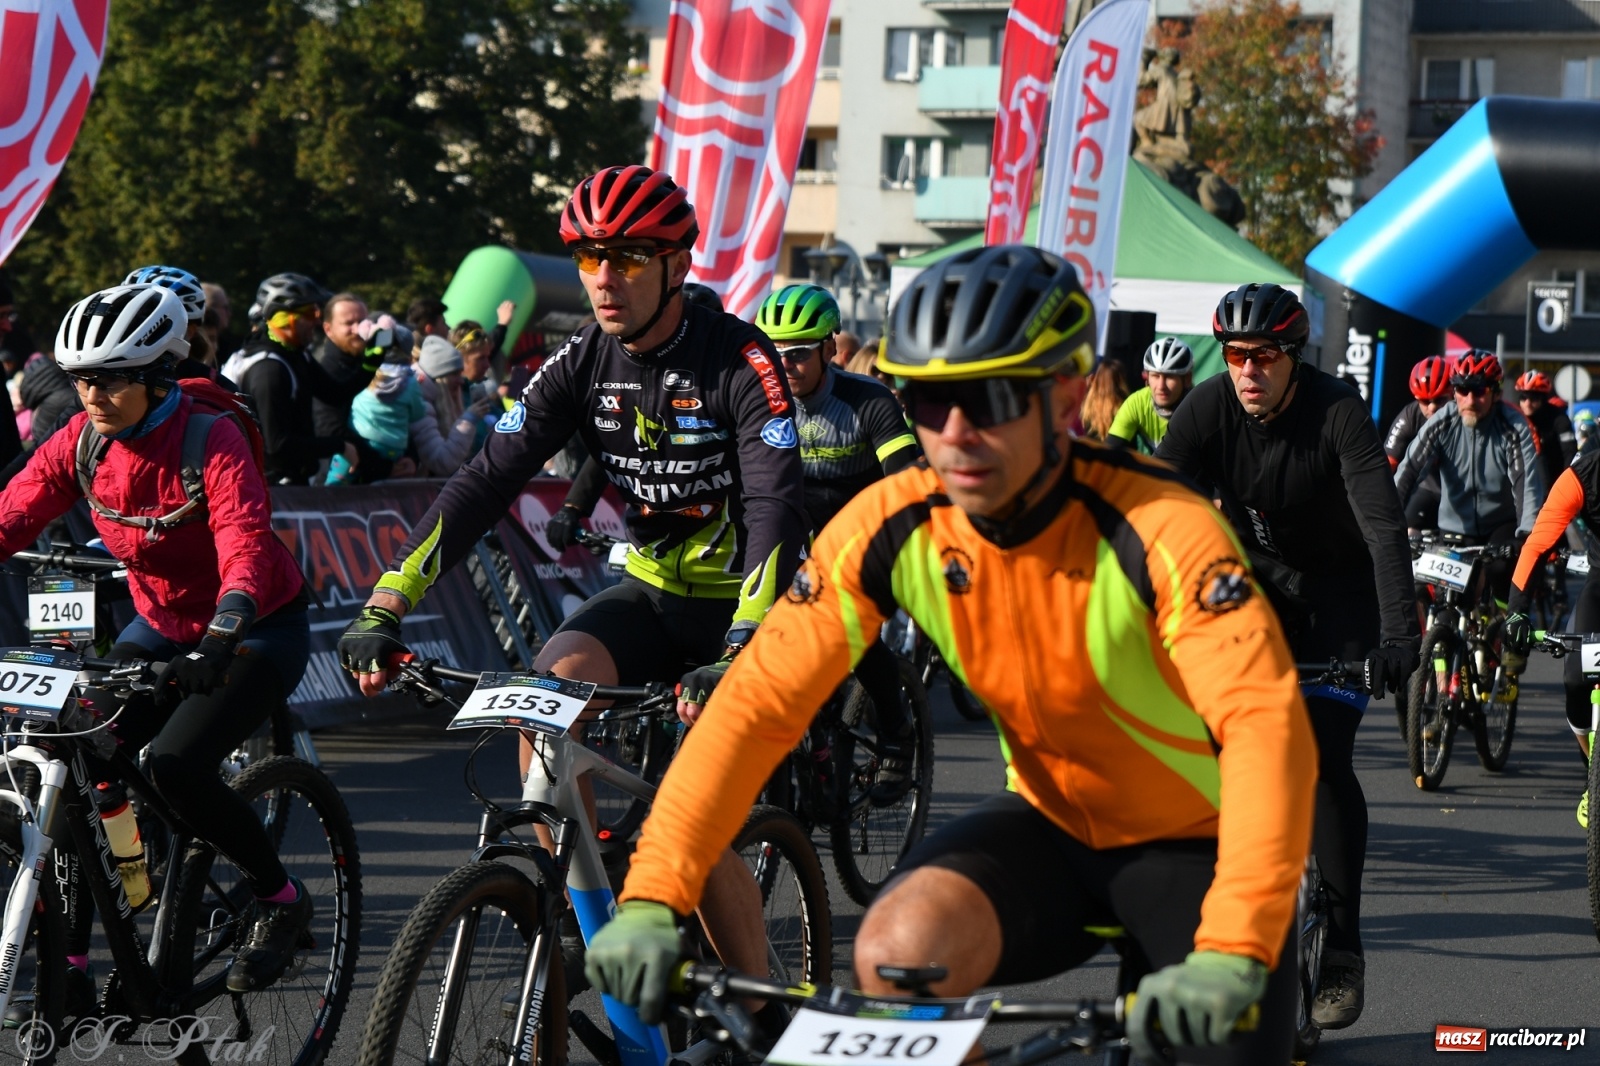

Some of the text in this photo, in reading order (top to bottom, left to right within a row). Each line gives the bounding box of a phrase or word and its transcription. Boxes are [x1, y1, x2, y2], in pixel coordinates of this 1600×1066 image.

[1537, 299, 1563, 333] 0
[671, 399, 697, 408] CST
[601, 451, 725, 475] MERIDA
[604, 469, 733, 503] MULTIVAN
[1428, 559, 1462, 578] 1432
[40, 602, 83, 622] 2140
[481, 692, 562, 717] 1553
[812, 1031, 938, 1059] 1310
